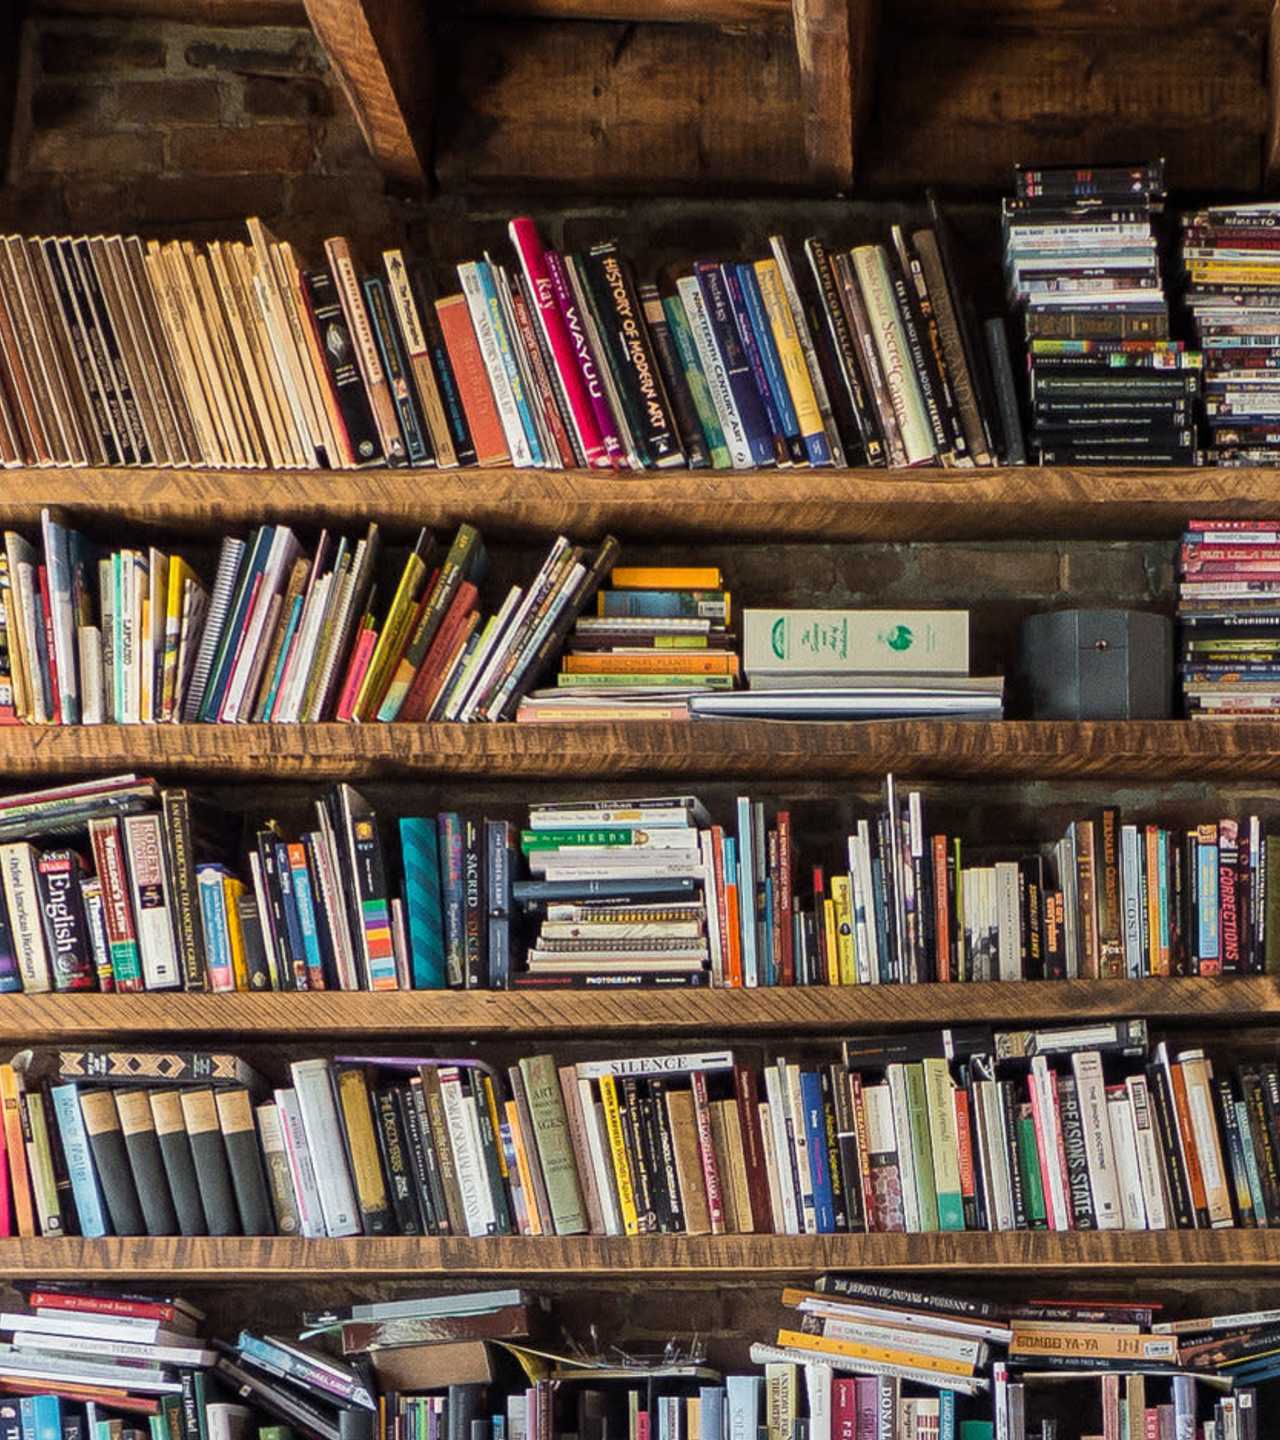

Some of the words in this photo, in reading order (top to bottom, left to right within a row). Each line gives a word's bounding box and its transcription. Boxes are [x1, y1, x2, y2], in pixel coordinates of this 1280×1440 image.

[535, 278, 557, 310] Ray
[603, 258, 632, 317] HISTORY
[622, 319, 641, 338] OF
[567, 307, 601, 398] WAYUU
[630, 340, 657, 399] MODERN
[646, 401, 667, 429] ART
[8, 857, 24, 887] Oxford
[12, 887, 29, 932] American
[46, 872, 76, 952] English
[1221, 867, 1239, 961] CORRECTIONS
[19, 933, 37, 980] Dictionary
[611, 1055, 687, 1072] SILENCE
[1062, 1102, 1083, 1168] REASONS
[1072, 1172, 1091, 1215] STATE
